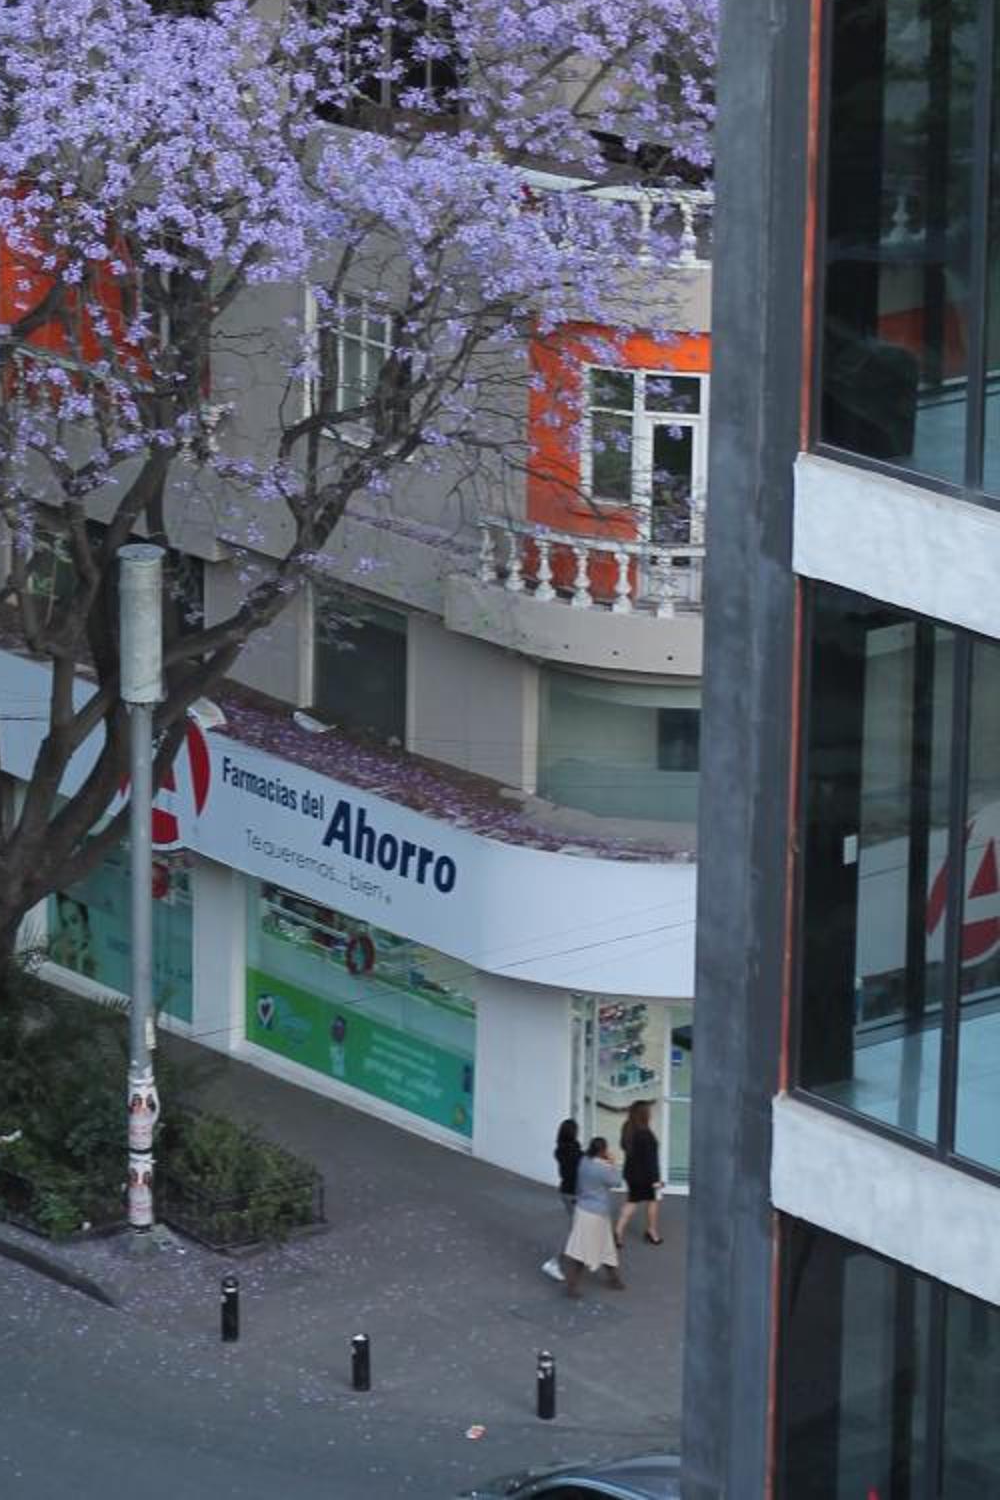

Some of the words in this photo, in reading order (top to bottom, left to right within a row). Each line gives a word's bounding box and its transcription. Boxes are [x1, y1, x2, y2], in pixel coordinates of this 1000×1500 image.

[222, 756, 298, 810] Farmacias
[301, 789, 324, 820] del
[322, 800, 457, 893] Ahorro
